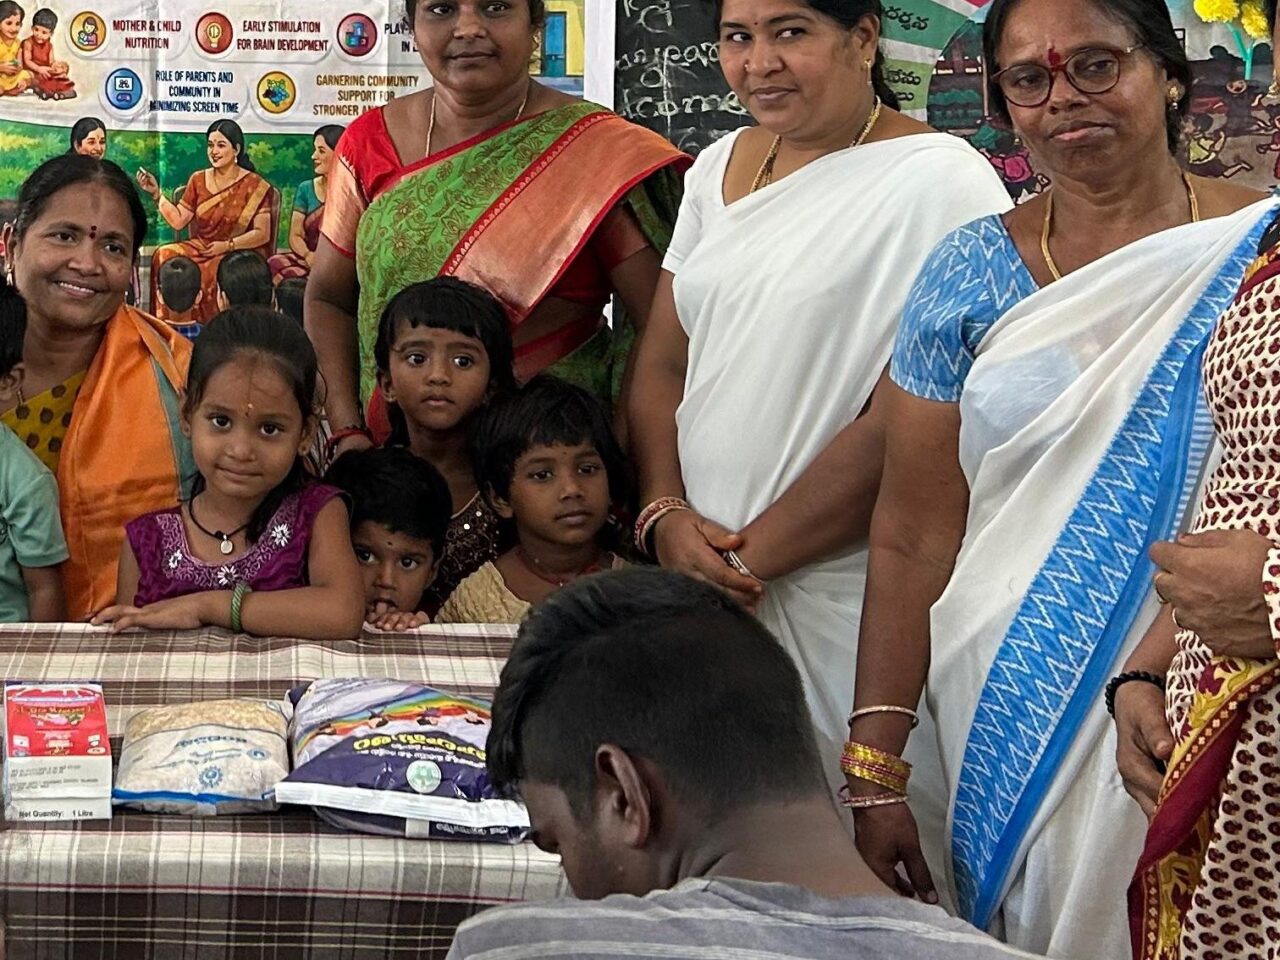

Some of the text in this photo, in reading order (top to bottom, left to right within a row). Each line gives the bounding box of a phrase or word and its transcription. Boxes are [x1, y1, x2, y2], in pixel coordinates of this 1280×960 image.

[113, 20, 147, 32] MOTHER
[149, 20, 156, 32] &
[242, 20, 320, 33] EARLY STIMULATION
[125, 38, 169, 49] NUTRITION
[237, 39, 328, 52] FOR BRAIN DEVELOPMENT
[155, 70, 233, 83] ROLE OF PARENTS AND
[316, 75, 419, 87] GARNERING COMMUNITY
[213, 86, 221, 98] IN
[338, 90, 377, 102] SUPPORT
[192, 101, 220, 113] SCREEN
[221, 102, 239, 113] TIME
[313, 104, 359, 116] STRONGER
